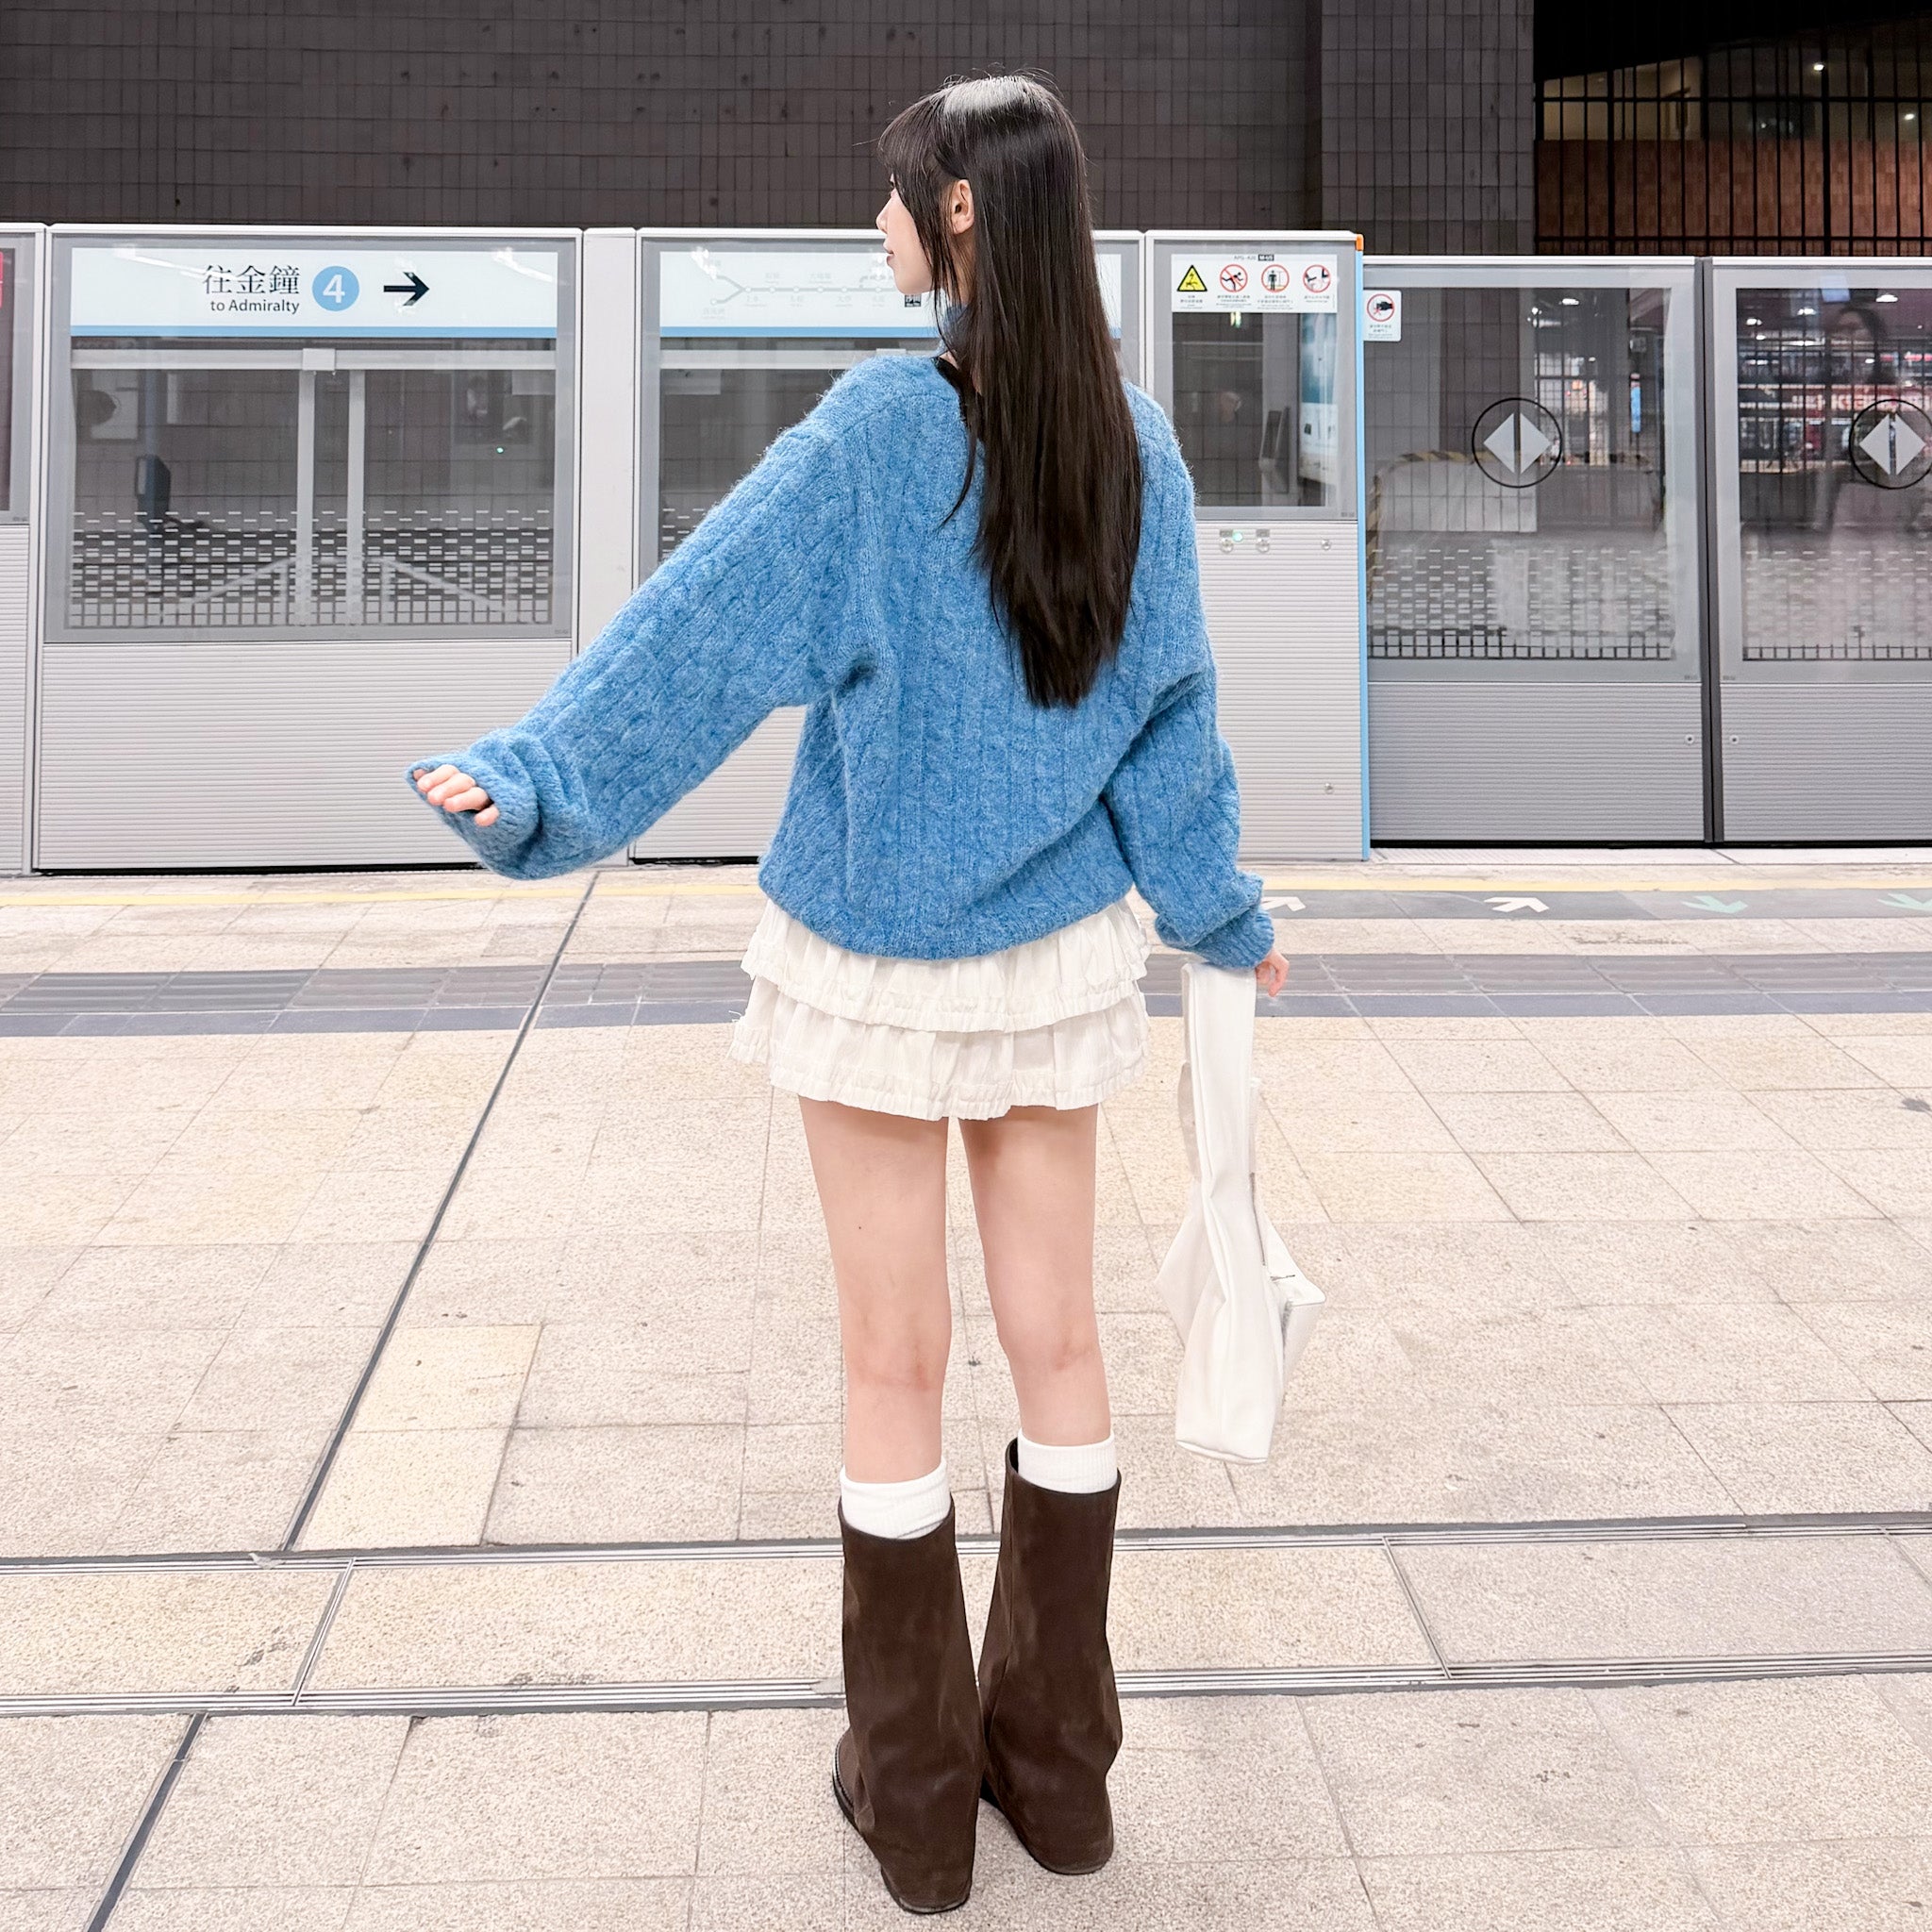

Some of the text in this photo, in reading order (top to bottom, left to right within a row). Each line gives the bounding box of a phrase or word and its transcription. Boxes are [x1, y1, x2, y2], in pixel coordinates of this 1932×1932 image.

[202, 265, 301, 294] 往金鐘
[323, 275, 345, 304] 4
[210, 299, 300, 315] to Admiralty
